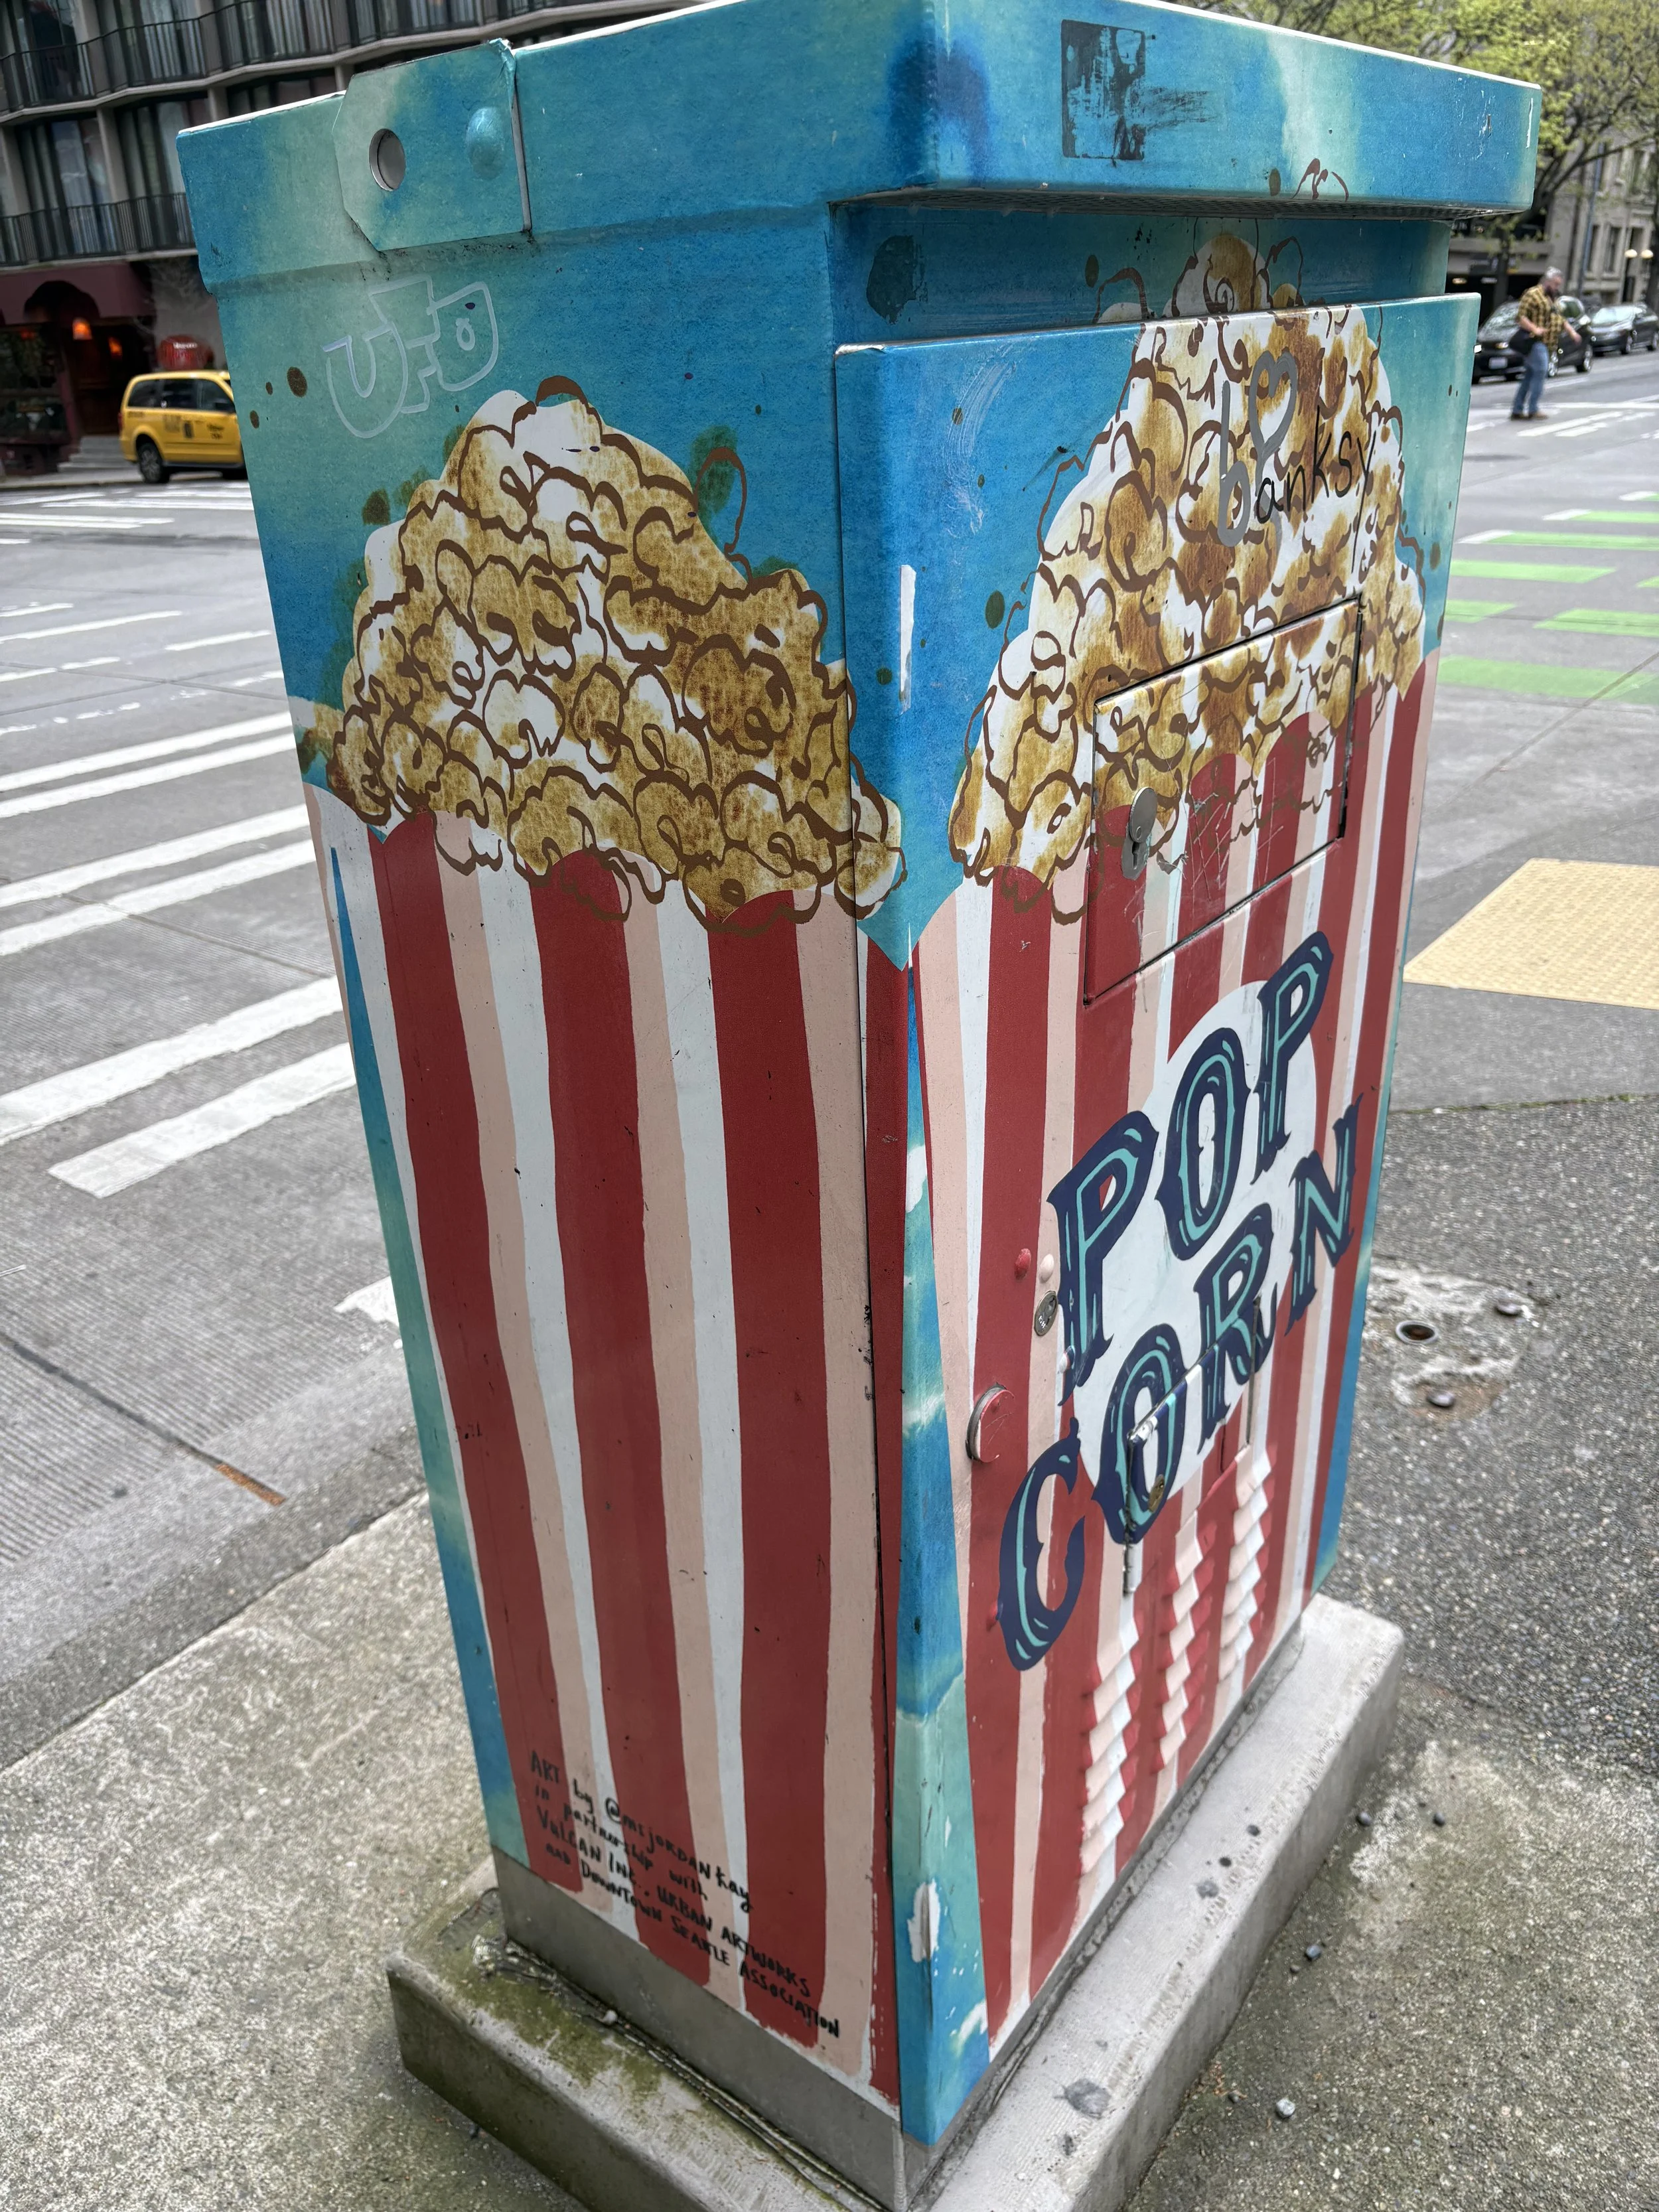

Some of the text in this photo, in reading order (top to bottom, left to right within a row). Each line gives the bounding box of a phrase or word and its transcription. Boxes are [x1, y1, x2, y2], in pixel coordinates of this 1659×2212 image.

[1046, 931, 1334, 1405] POP
[997, 1094, 1362, 1670] CORN
[531, 1750, 559, 1784] ART
[573, 1778, 594, 1814] by
[669, 1870, 707, 1901] with
[739, 1960, 839, 2038] ASSOCIATION
